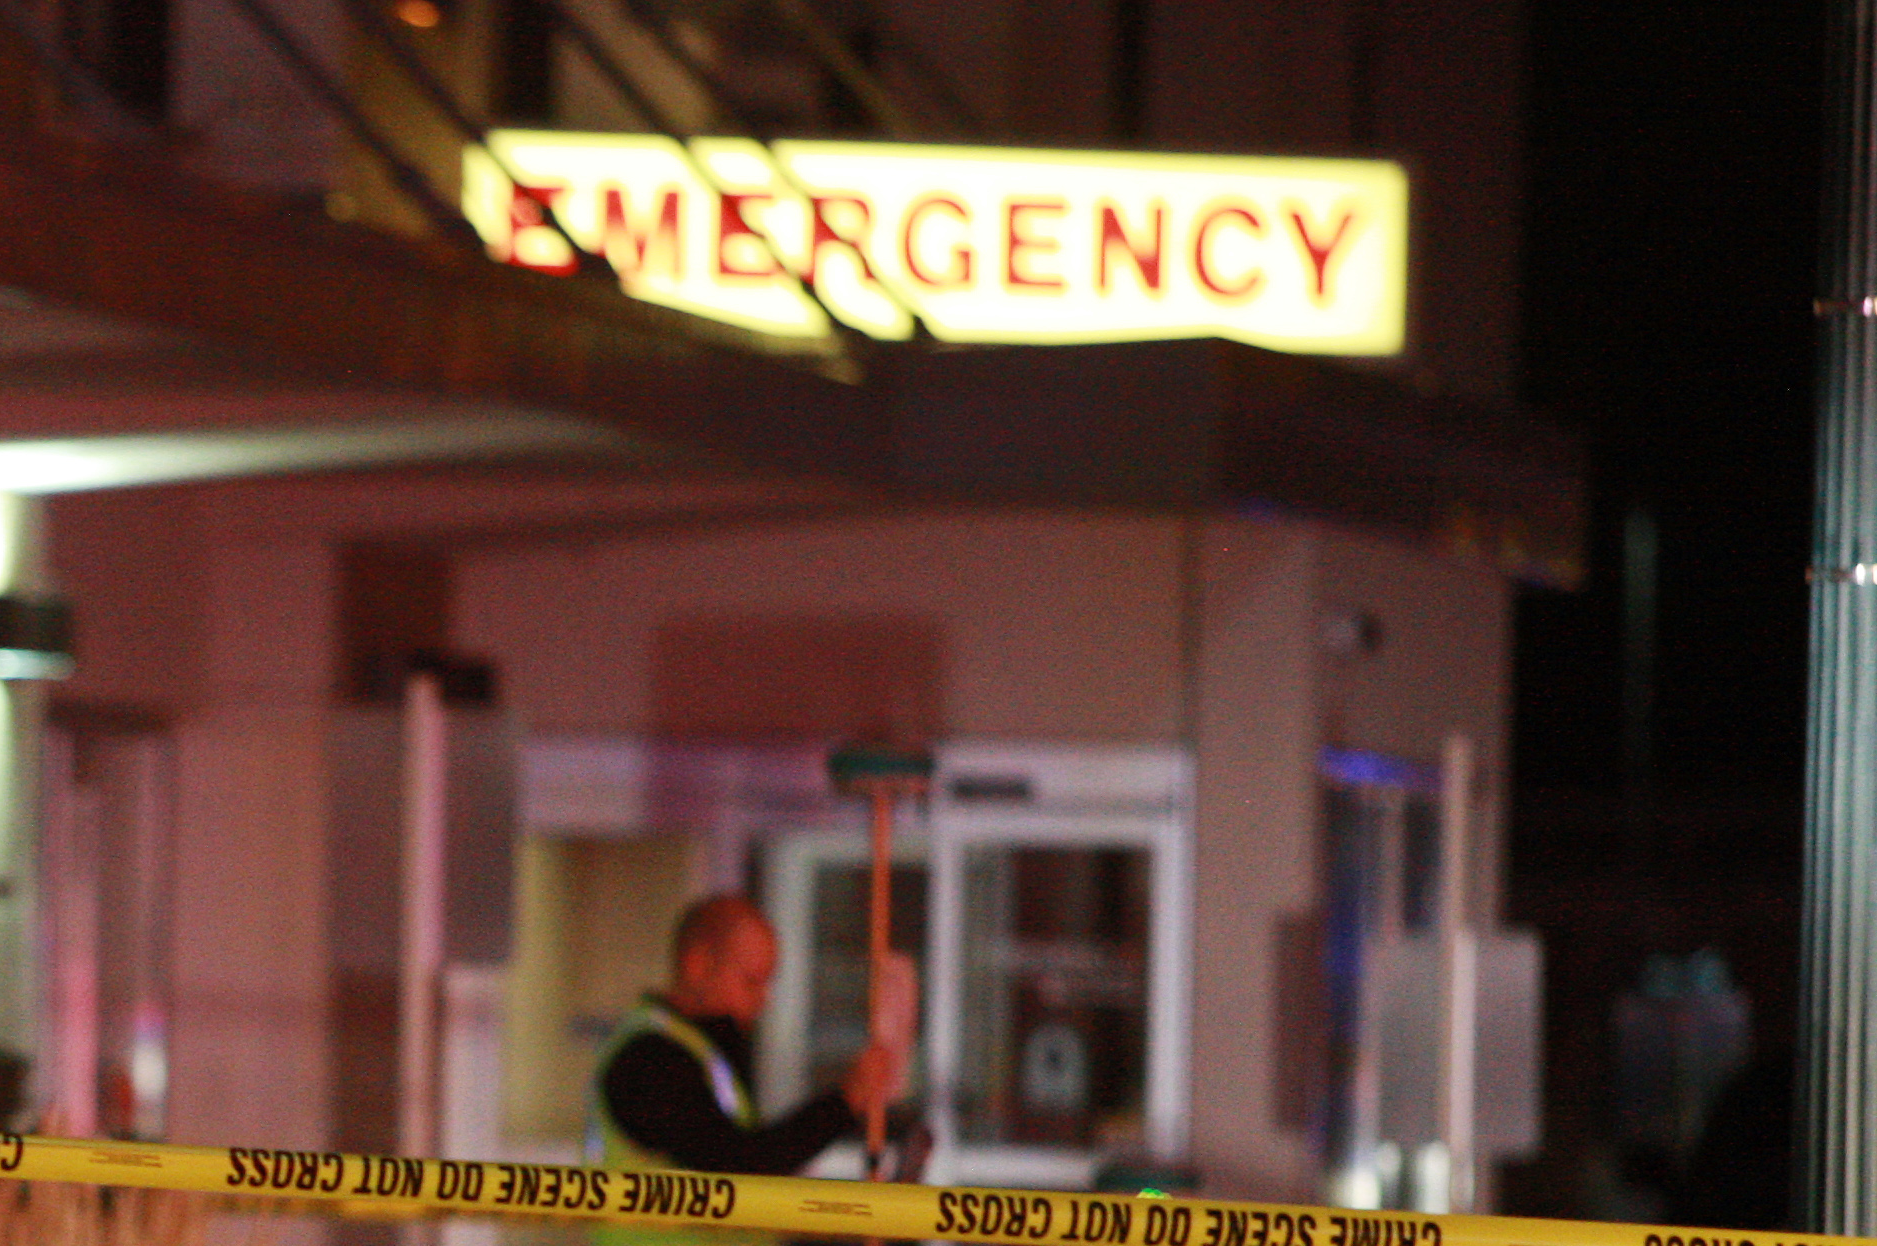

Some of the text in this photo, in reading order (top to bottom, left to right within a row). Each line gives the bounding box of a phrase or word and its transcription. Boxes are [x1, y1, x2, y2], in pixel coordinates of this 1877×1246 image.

[509, 183, 1355, 303] EMERGENCY
[226, 1147, 736, 1219] CRIME SCENE DO NOT CROSS
[935, 1191, 1053, 1239] CROSS
[1061, 1198, 1133, 1244] NOT
